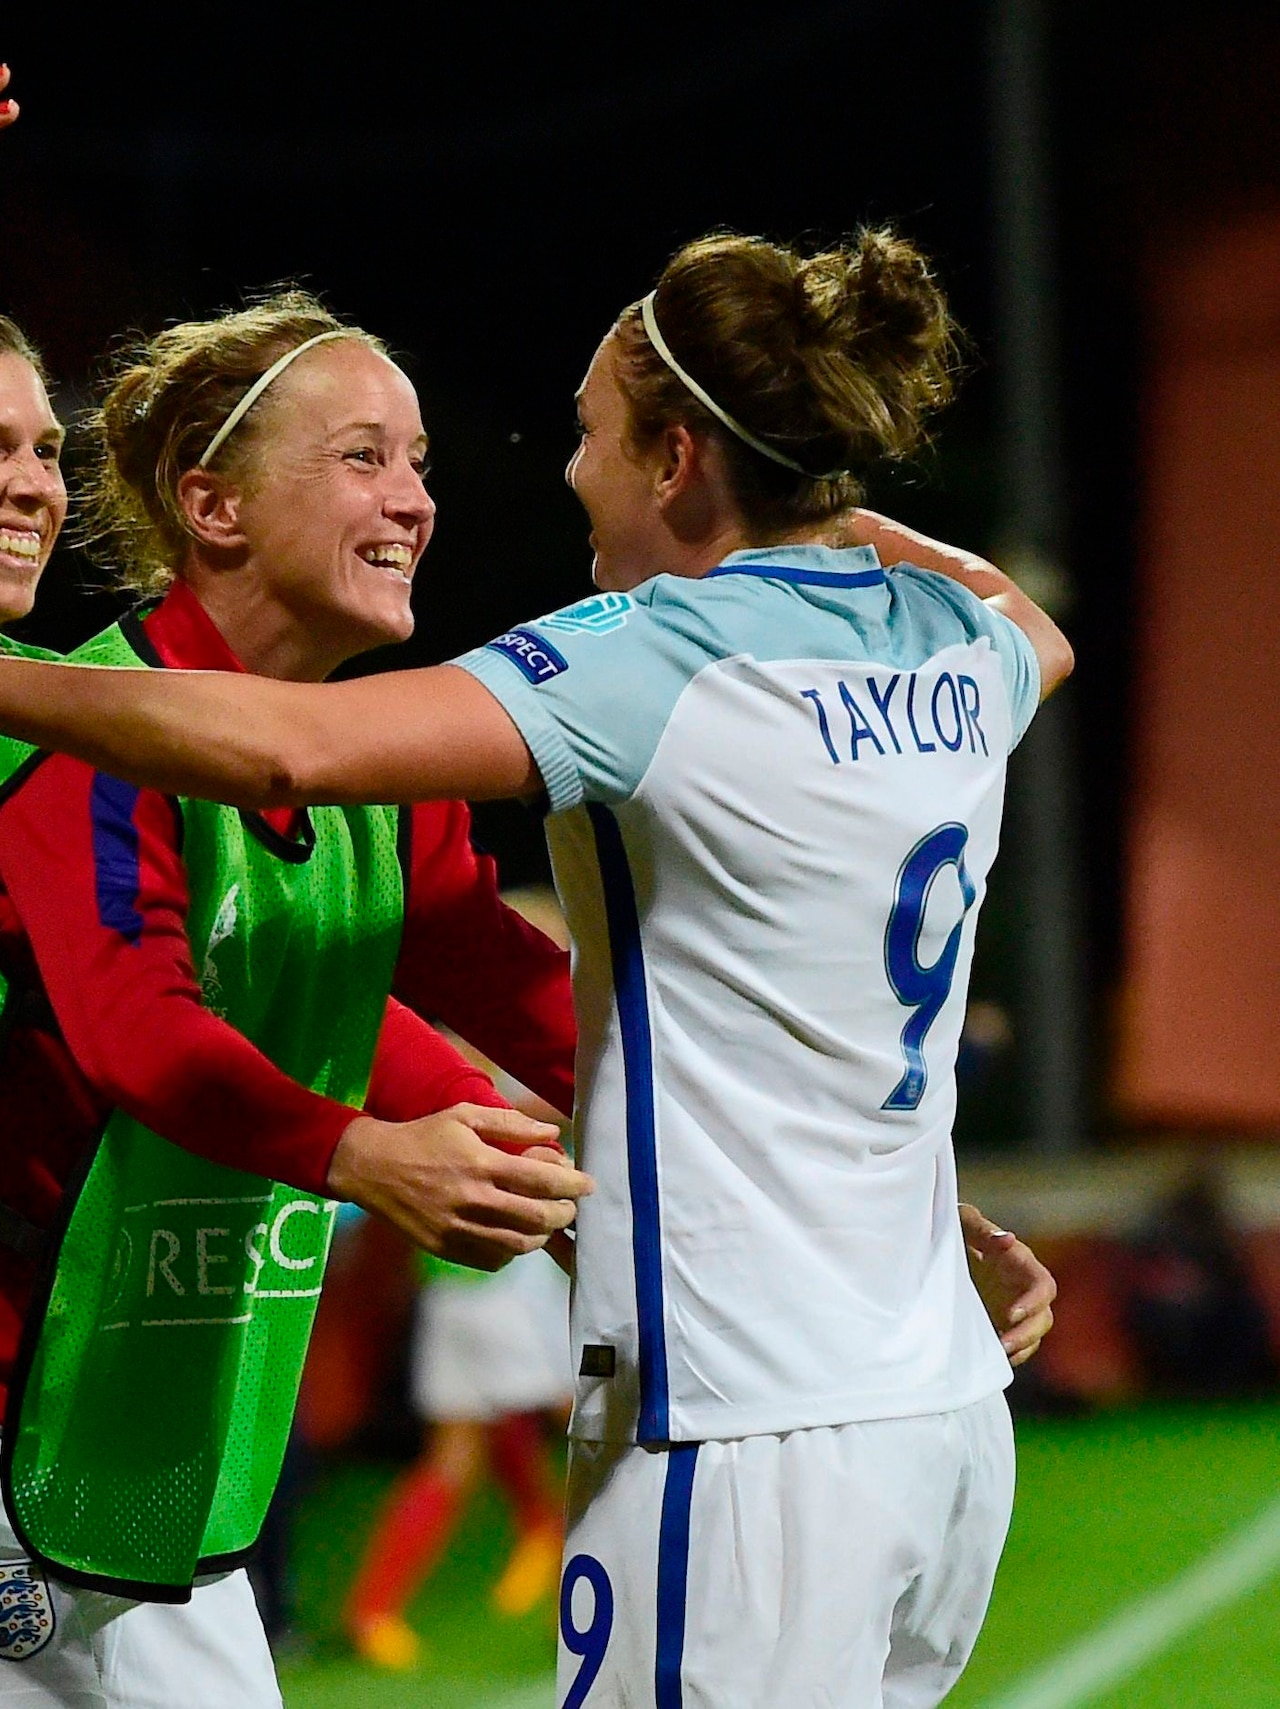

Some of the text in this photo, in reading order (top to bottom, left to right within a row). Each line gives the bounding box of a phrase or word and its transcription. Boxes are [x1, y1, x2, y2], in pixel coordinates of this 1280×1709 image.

[799, 671, 989, 764] TAYLOR
[880, 821, 976, 1110] 9
[560, 1554, 613, 1709] 9
